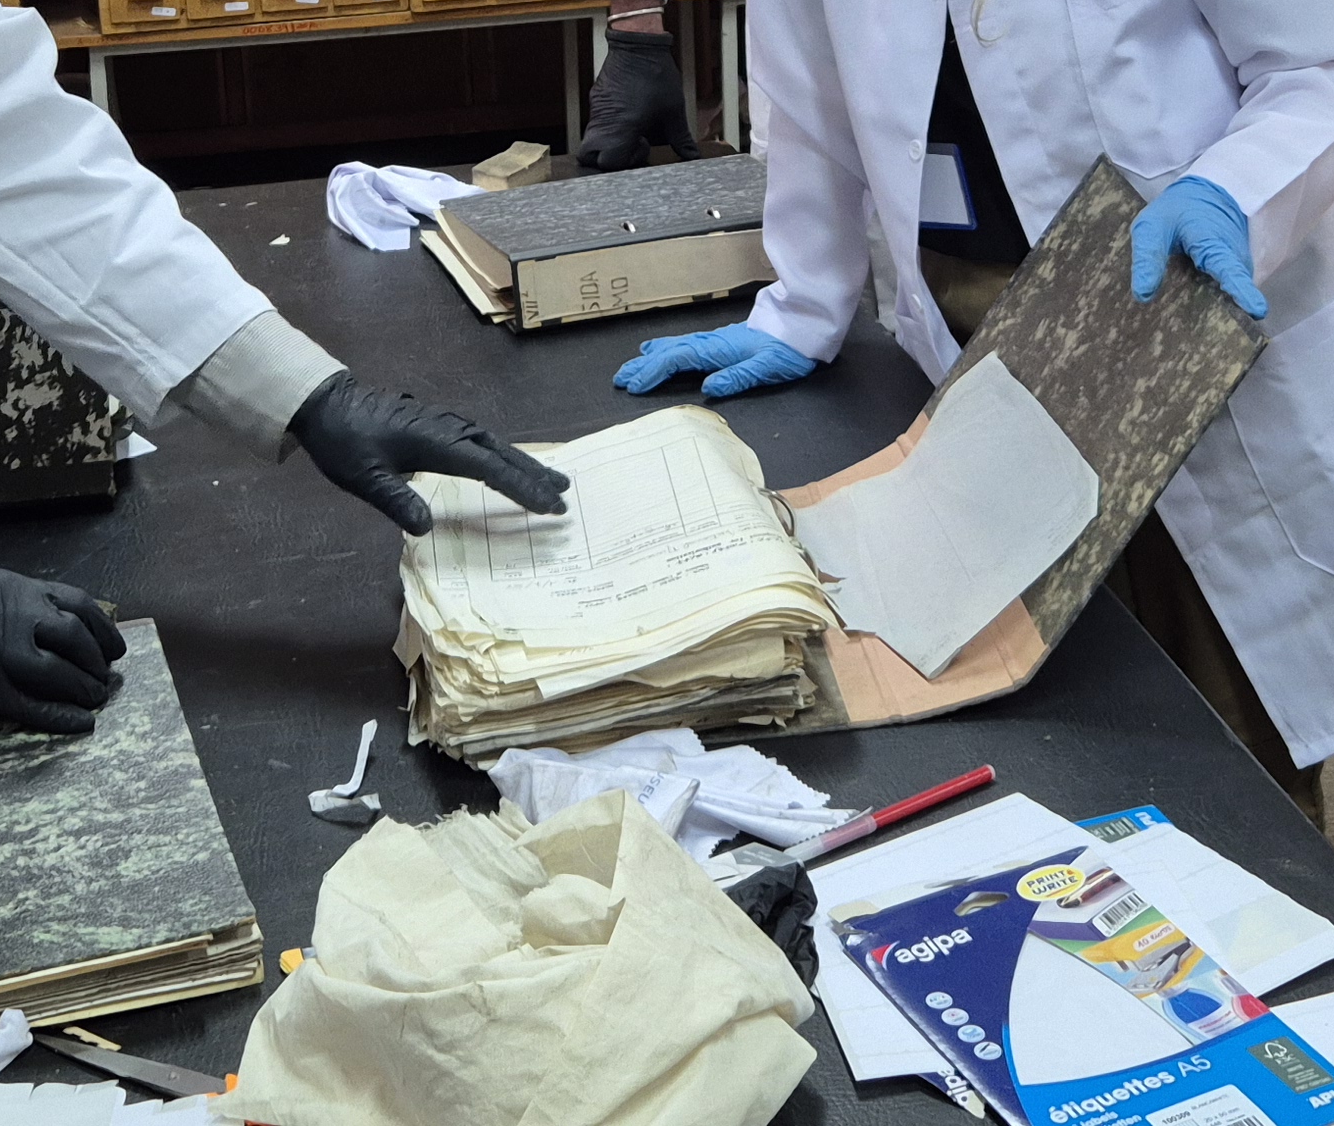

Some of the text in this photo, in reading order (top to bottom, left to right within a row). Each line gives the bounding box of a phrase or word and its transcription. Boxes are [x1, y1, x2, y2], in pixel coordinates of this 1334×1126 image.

[1026, 870, 1066, 889] PRINT
[1032, 876, 1079, 895] WRITE
[894, 928, 974, 964] agipa
[1049, 1054, 1212, 1124] étiquettes A5
